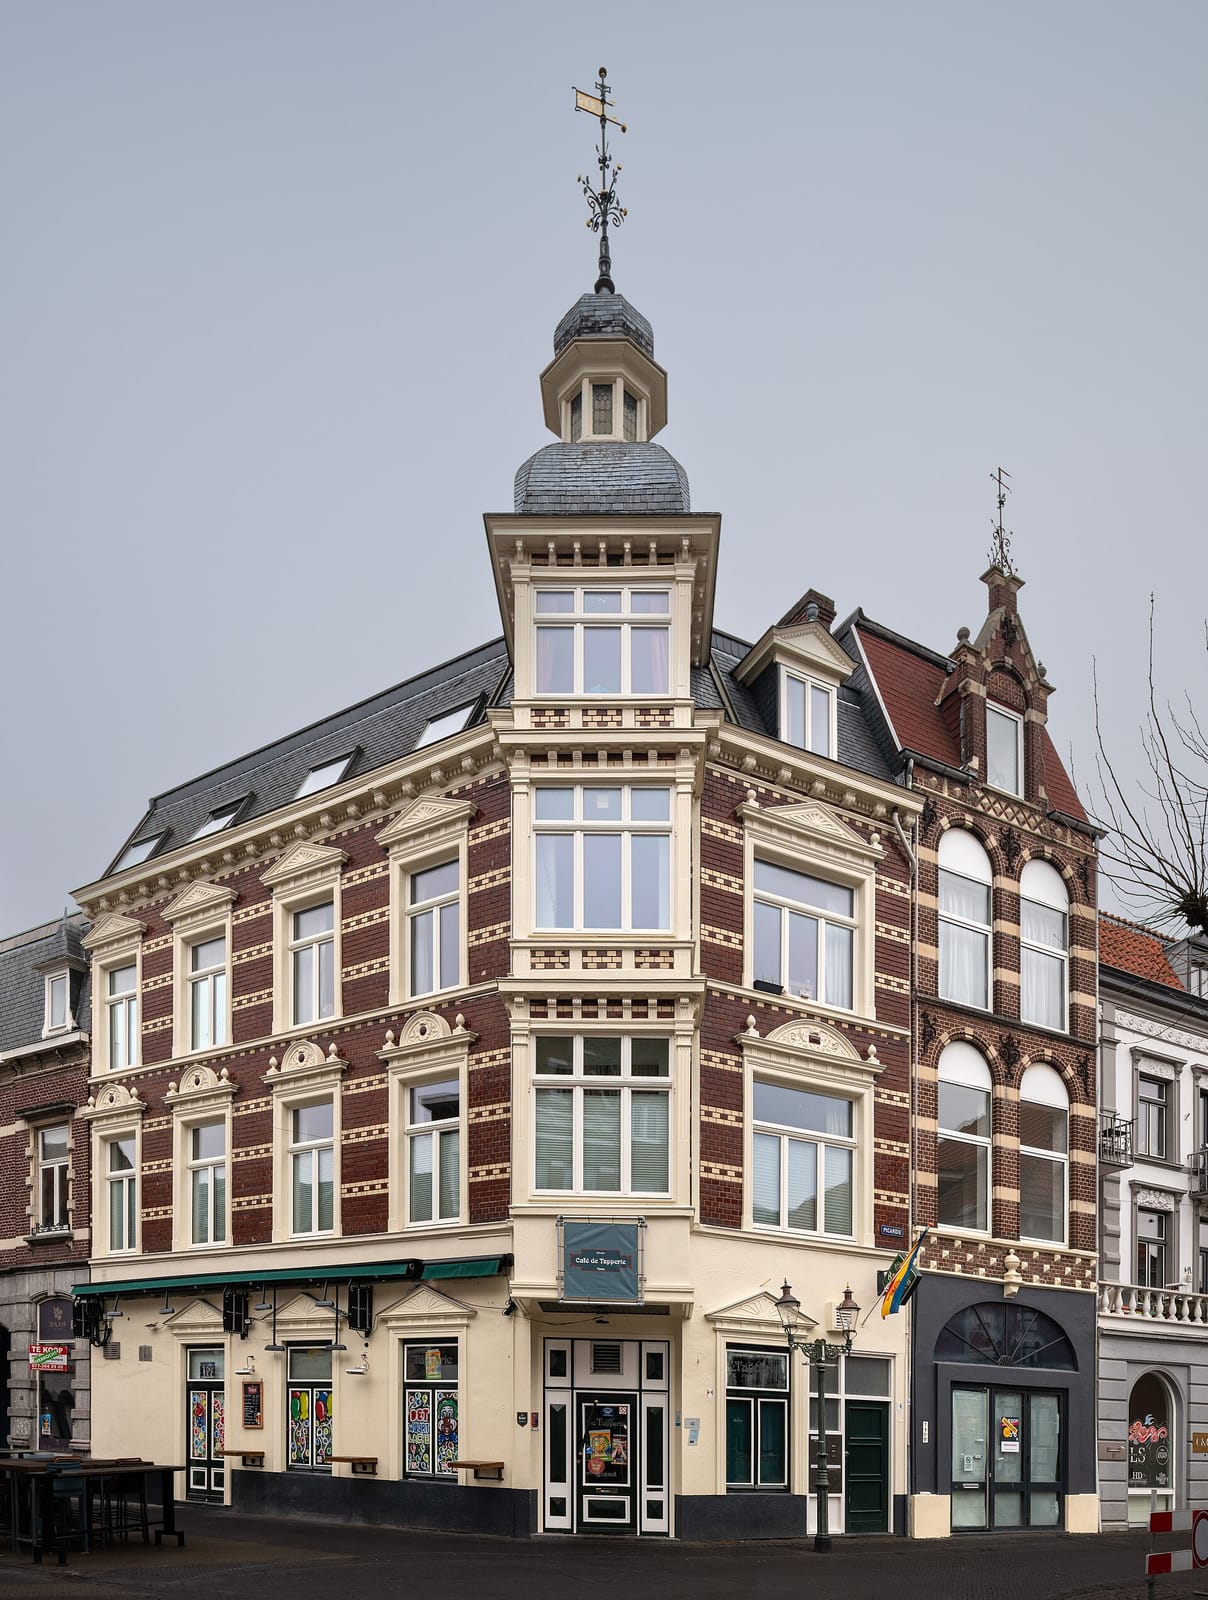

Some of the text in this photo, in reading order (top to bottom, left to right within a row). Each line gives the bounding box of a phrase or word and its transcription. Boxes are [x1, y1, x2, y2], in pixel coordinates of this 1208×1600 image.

[882, 1227, 902, 1236] PICARDIE
[599, 1258, 627, 1266] Tapperie
[42, 1346, 64, 1354] KOOP
